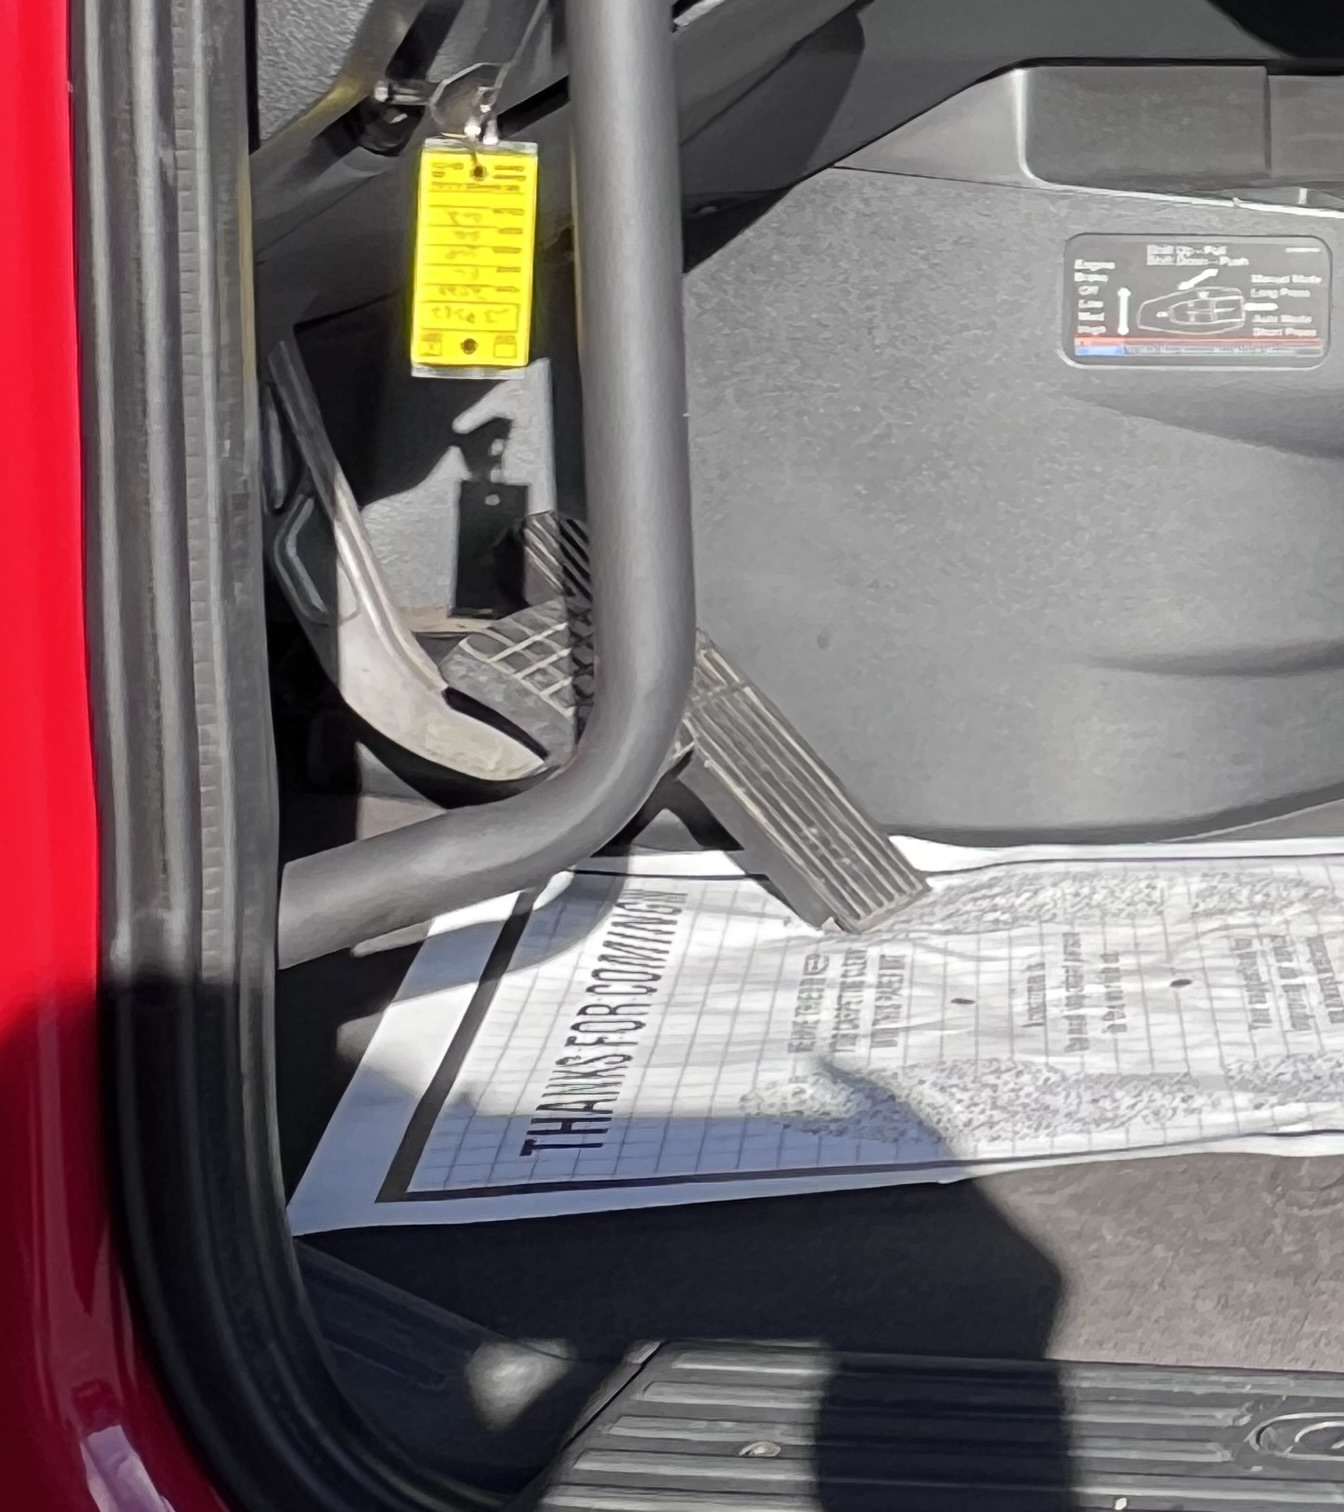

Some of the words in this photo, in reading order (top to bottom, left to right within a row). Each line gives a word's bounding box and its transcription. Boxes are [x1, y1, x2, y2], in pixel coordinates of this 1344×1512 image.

[584, 901, 684, 996] COMING
[563, 1002, 653, 1048] FOR
[518, 1053, 635, 1158] THANKS
